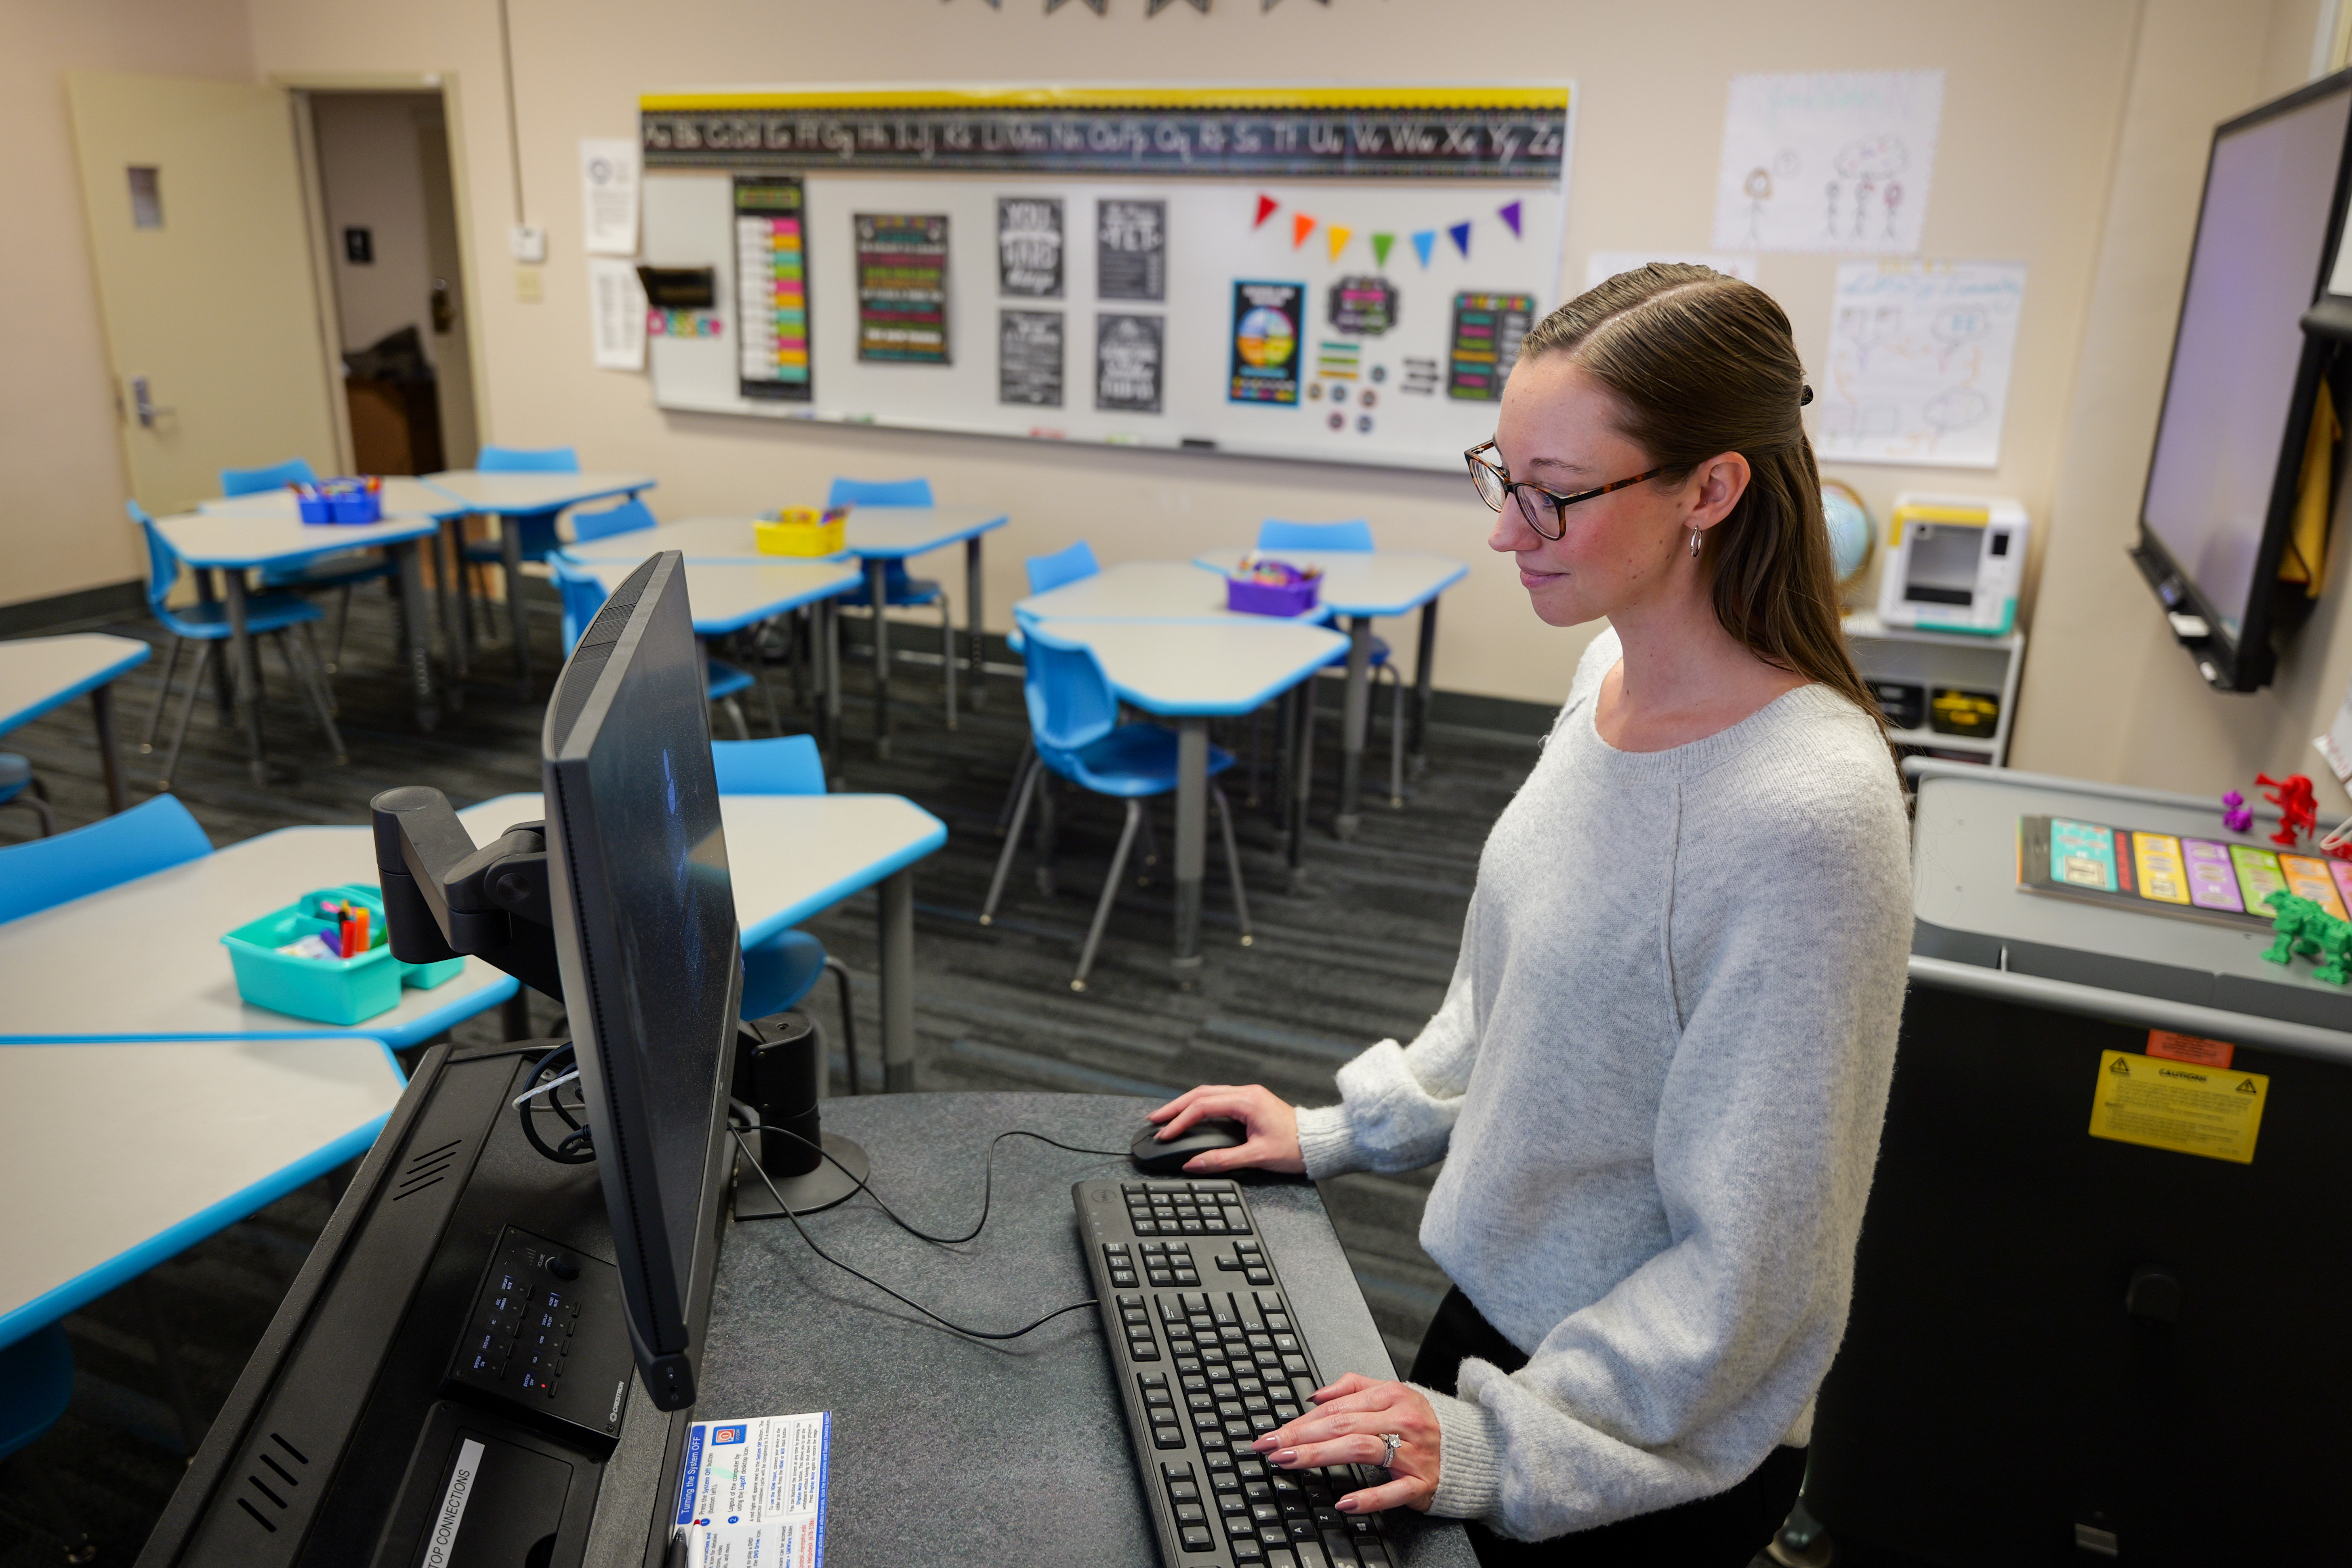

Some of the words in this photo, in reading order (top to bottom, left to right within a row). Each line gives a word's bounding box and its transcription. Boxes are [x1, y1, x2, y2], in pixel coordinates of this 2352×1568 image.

[612, 1381, 624, 1413] CRESTRON
[692, 1436, 700, 1450] OFF
[688, 1452, 698, 1474] System
[686, 1476, 694, 1487] the
[437, 1469, 470, 1545] CONNECTIONS
[681, 1488, 694, 1513] Turning
